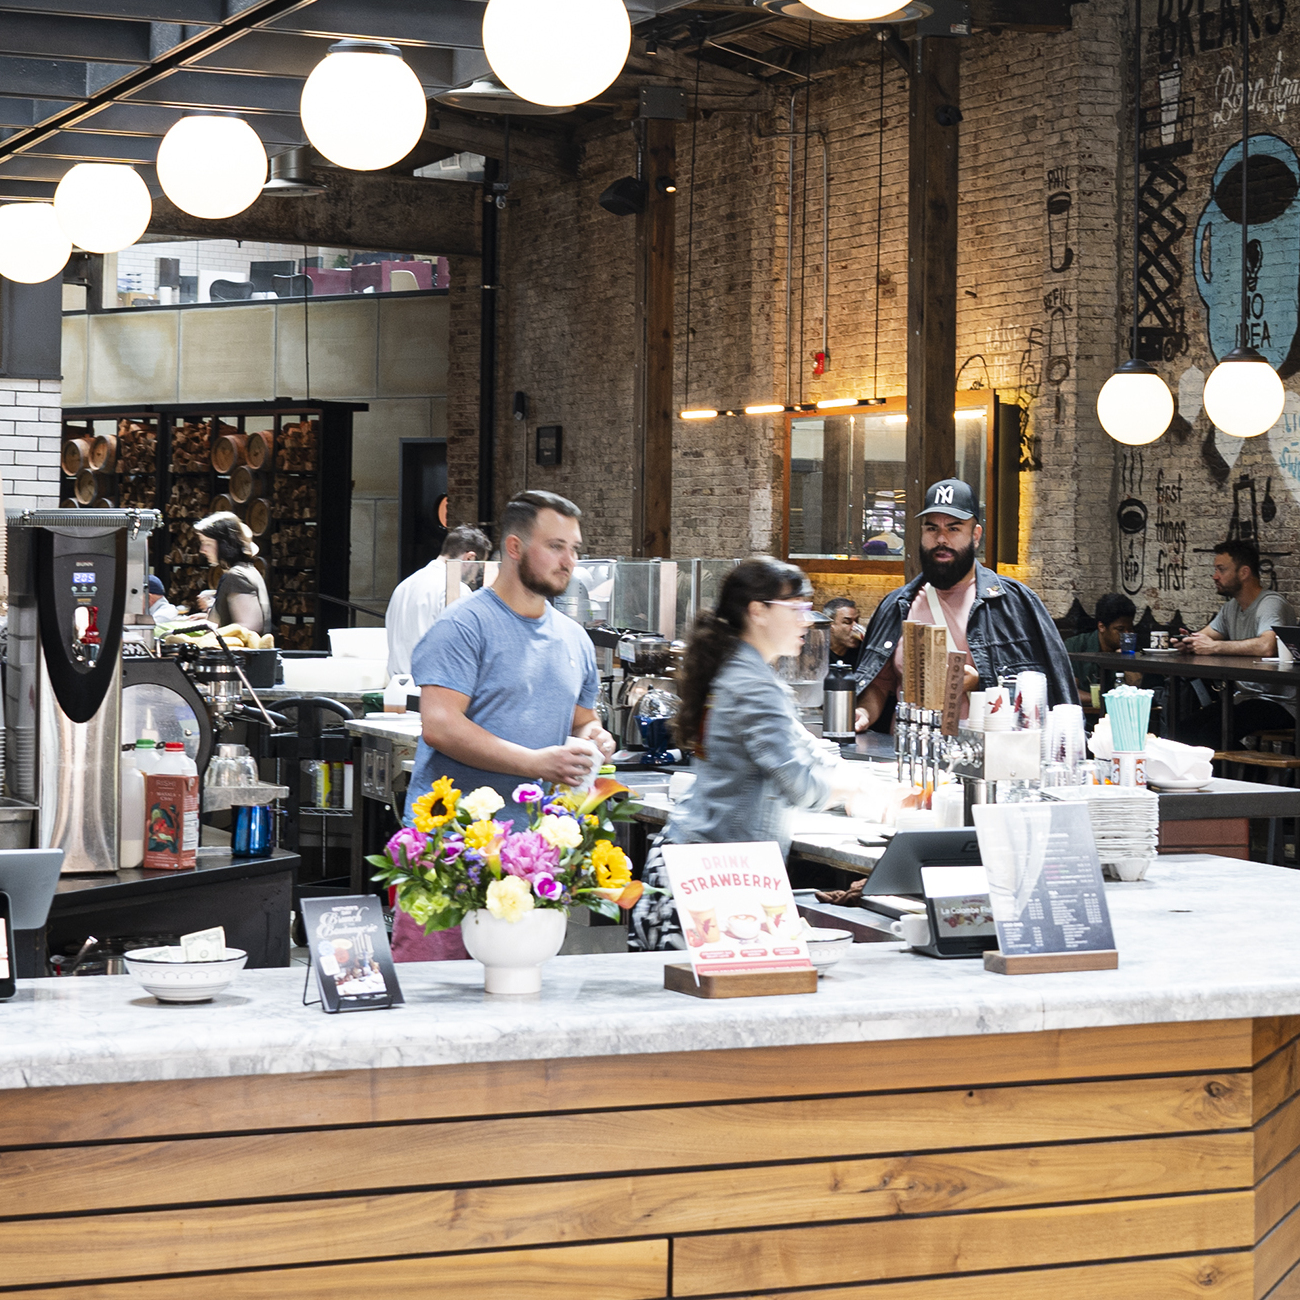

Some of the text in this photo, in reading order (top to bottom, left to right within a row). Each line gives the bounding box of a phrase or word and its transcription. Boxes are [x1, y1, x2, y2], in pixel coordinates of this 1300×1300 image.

[1156, 469, 1184, 504] first
[73, 573, 95, 583] 205
[1156, 550, 1188, 592] first
[702, 855, 750, 870] DRINK
[680, 873, 782, 895] STRAWBERRY
[950, 906, 980, 914] Colombe
